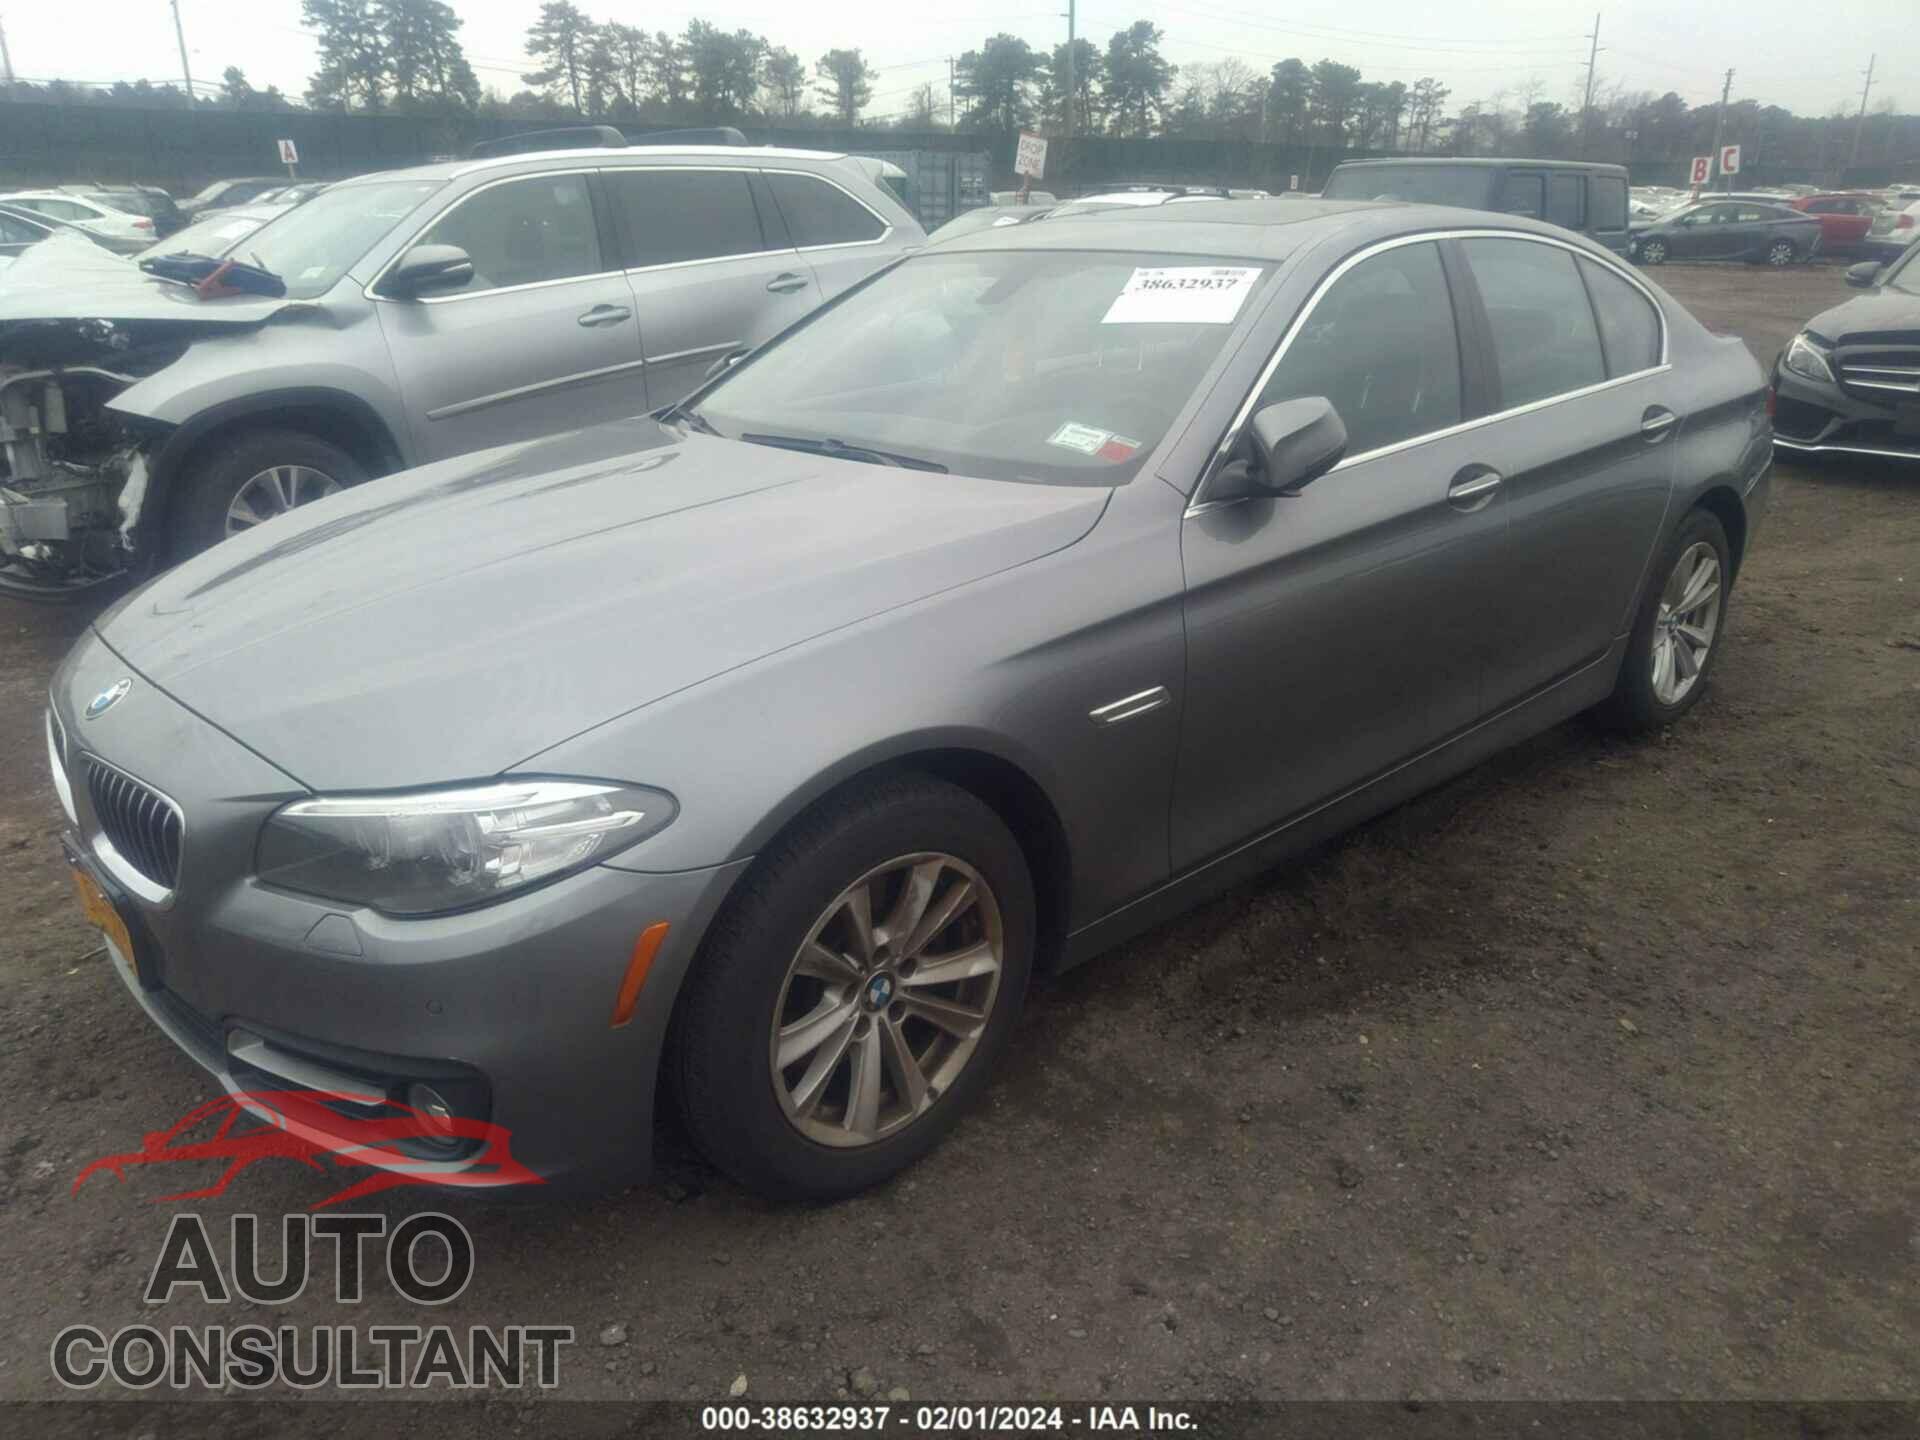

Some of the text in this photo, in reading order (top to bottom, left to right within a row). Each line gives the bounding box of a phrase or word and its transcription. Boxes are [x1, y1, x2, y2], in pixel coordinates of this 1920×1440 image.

[284, 142, 296, 160] A
[1020, 139, 1045, 154] DROP
[1017, 153, 1041, 170] ZONE
[1723, 148, 1737, 171] C
[1693, 159, 1708, 181] B
[1135, 278, 1239, 291] 38632937
